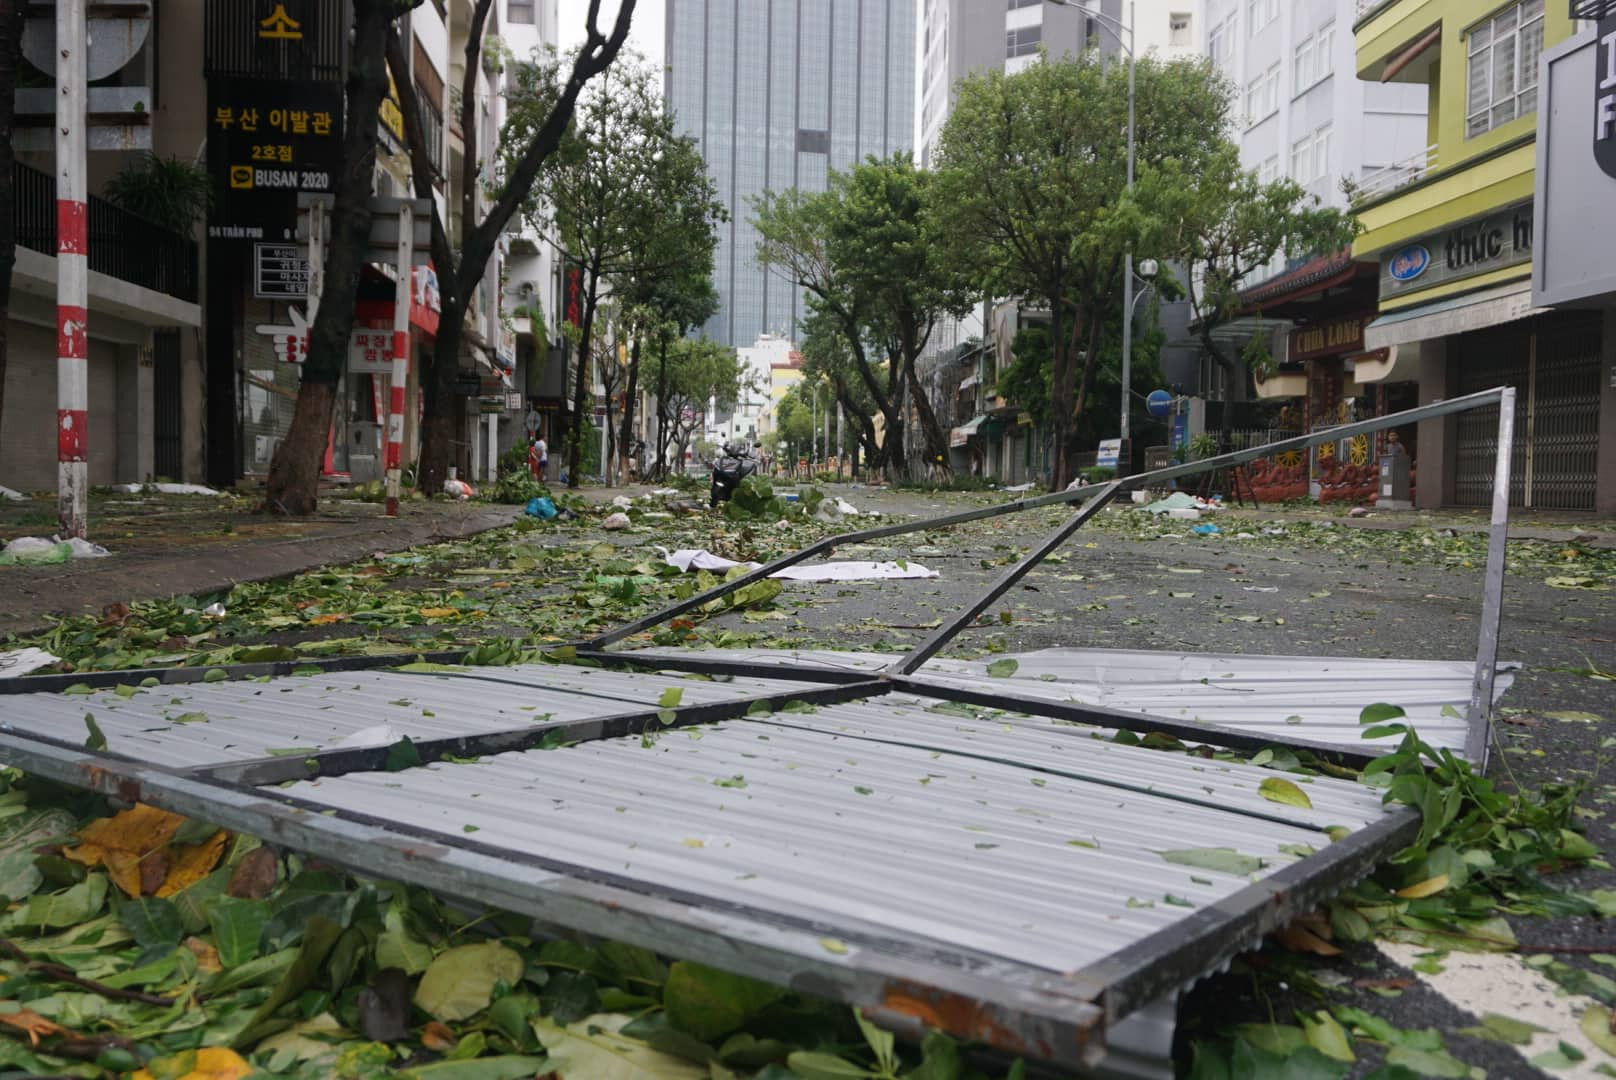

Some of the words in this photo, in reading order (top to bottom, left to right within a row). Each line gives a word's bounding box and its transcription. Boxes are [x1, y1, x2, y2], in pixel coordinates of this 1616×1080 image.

[258, 3, 303, 38] 소
[215, 107, 259, 131] 부산
[269, 109, 332, 134] 이발관
[251, 145, 293, 161] 2호점
[255, 169, 298, 187] BUSAN
[301, 172, 329, 188] 2020
